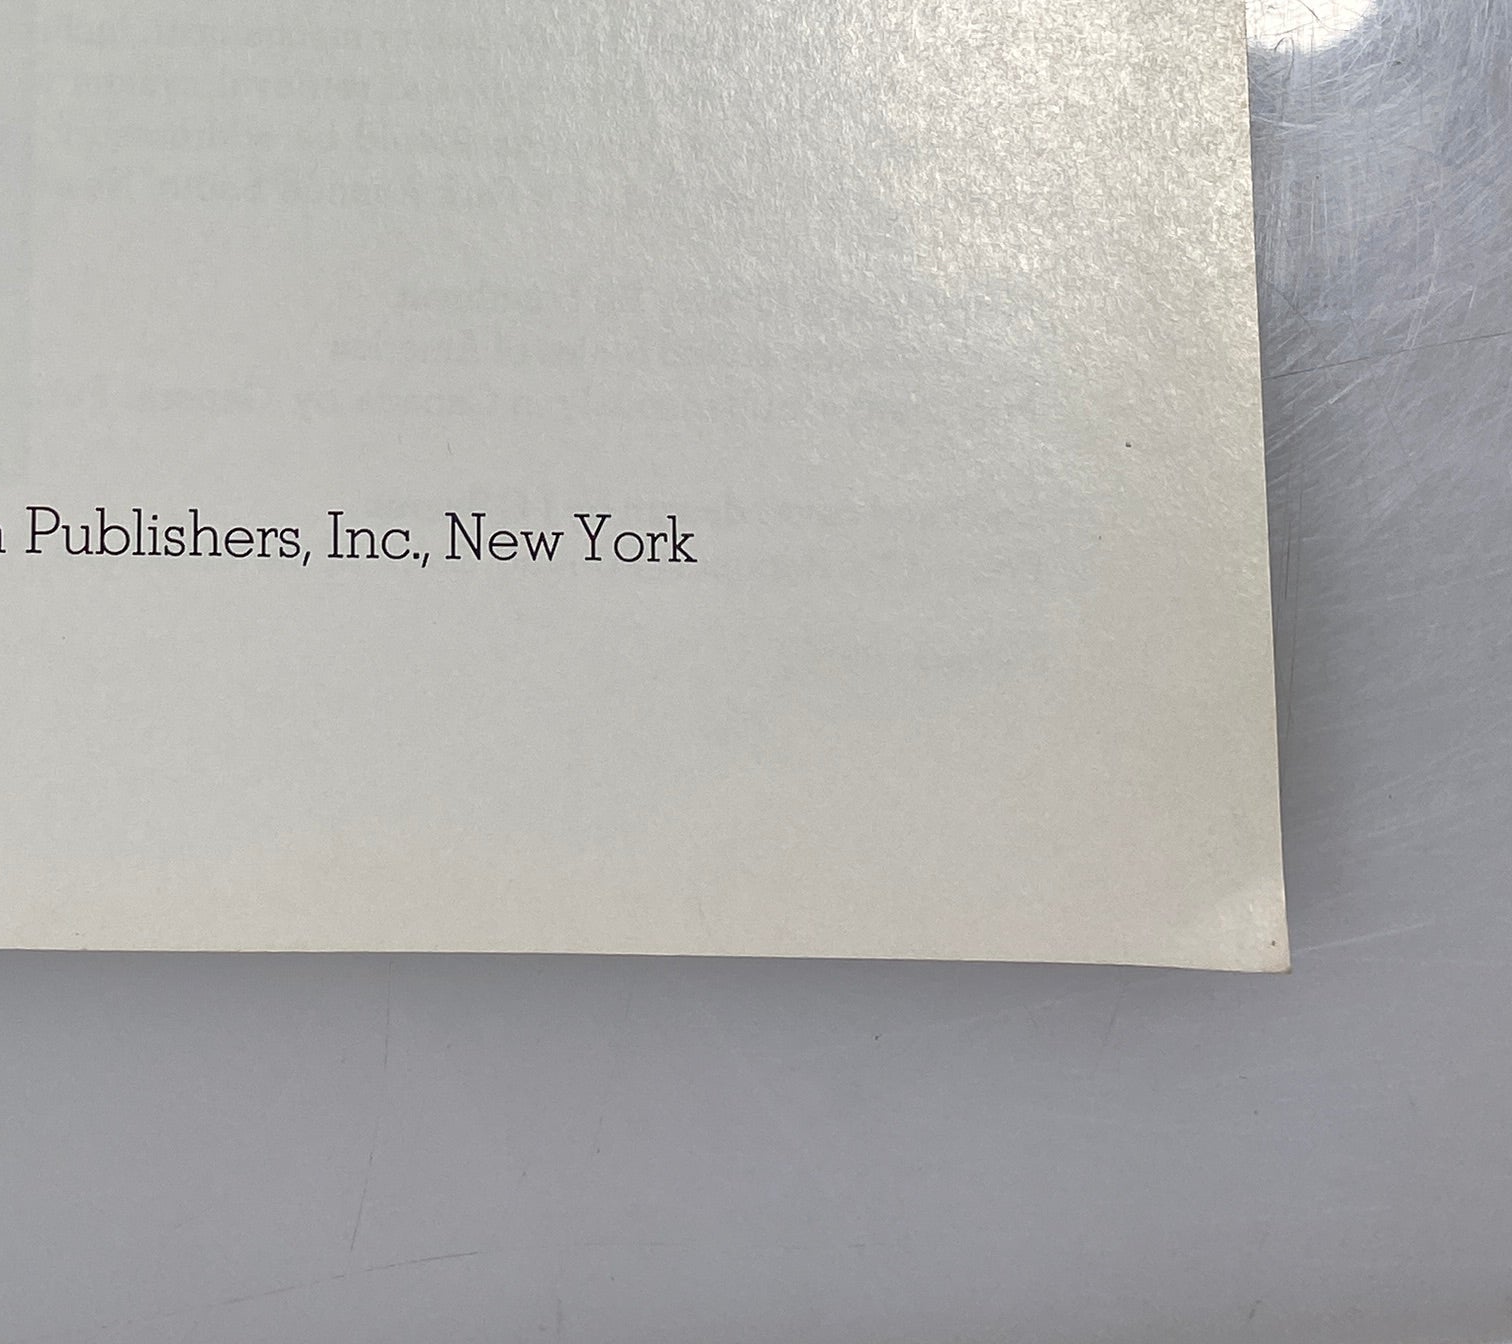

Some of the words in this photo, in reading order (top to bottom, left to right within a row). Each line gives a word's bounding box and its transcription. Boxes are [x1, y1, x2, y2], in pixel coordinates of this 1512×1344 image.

[26, 506, 310, 568] Publishers,
[328, 511, 429, 569] Inc.,
[445, 512, 564, 561] New
[574, 514, 698, 563] York
